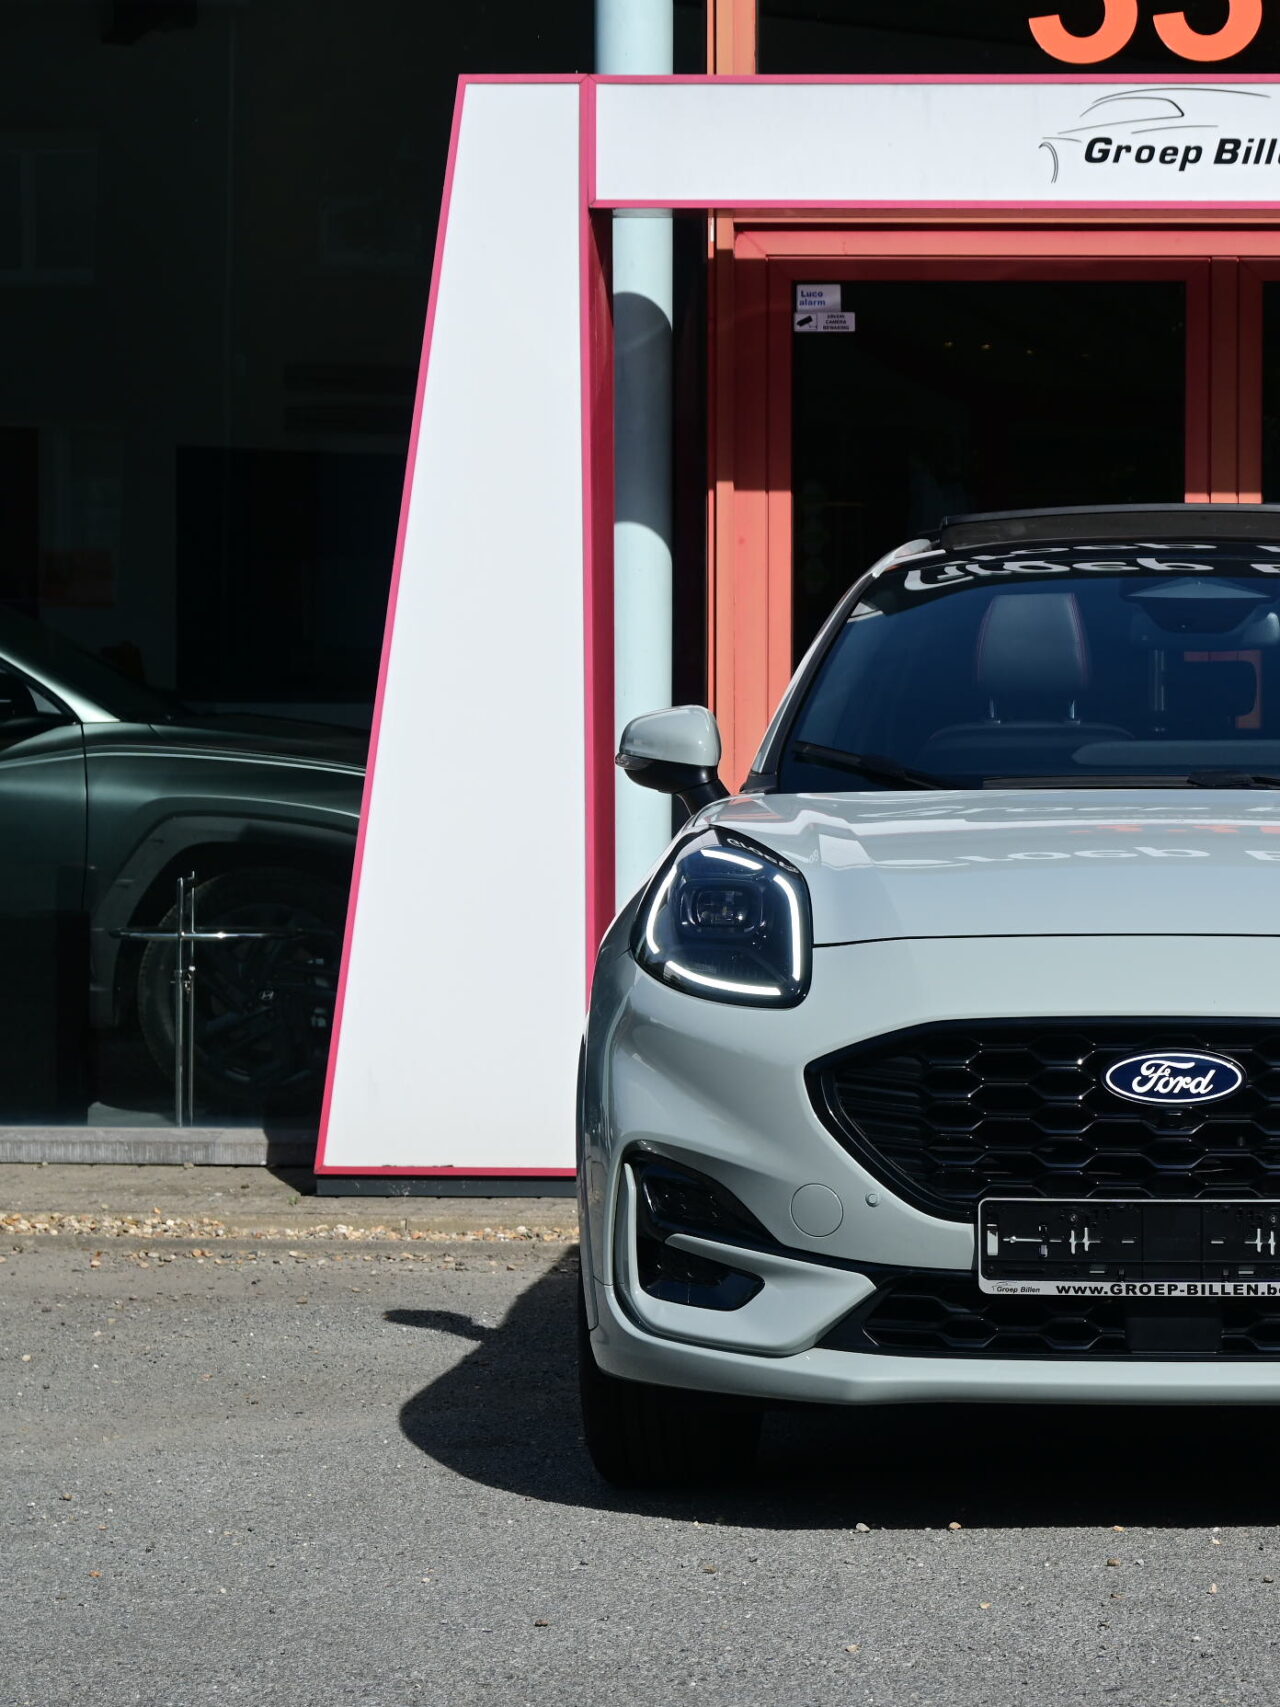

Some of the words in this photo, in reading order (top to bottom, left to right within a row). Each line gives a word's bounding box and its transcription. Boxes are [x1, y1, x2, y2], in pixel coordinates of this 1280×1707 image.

[1083, 137, 1203, 171] Groep
[800, 298, 826, 306] alarm
[1132, 1060, 1215, 1094] Ford
